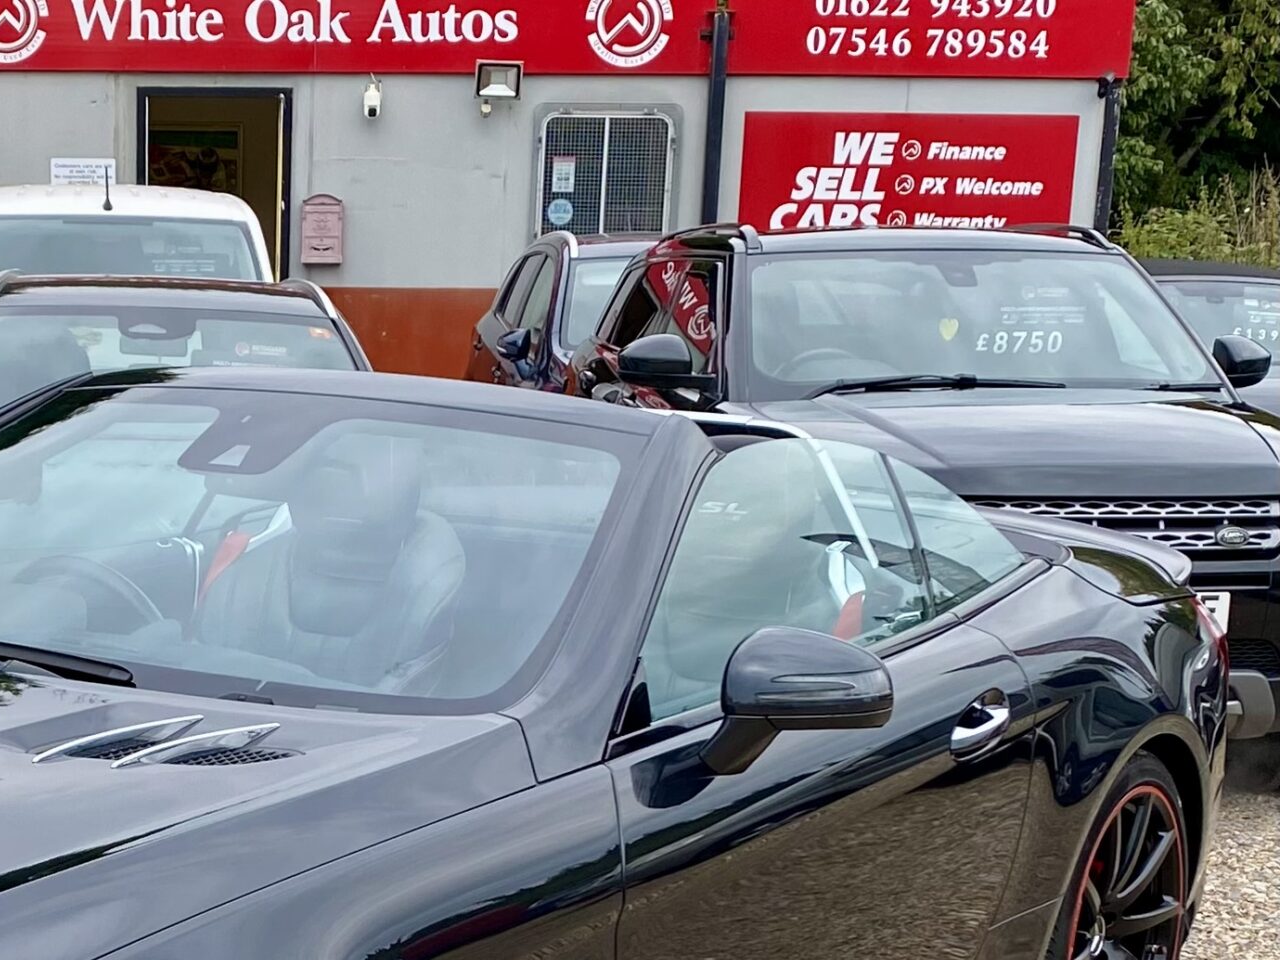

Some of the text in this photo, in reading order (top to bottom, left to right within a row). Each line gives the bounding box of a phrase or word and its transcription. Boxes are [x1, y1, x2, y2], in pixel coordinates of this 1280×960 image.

[69, 0, 519, 43] White Oak Autos
[815, 0, 1057, 18] 01622 943920
[806, 26, 1049, 58] 07546 789584
[833, 132, 900, 166] WE
[927, 142, 1007, 161] Finance
[790, 167, 885, 201] SELL
[919, 177, 1044, 196] PX Welcome
[770, 203, 881, 229] CARS
[915, 212, 1007, 228] Warranty
[975, 330, 1063, 354] £8750
